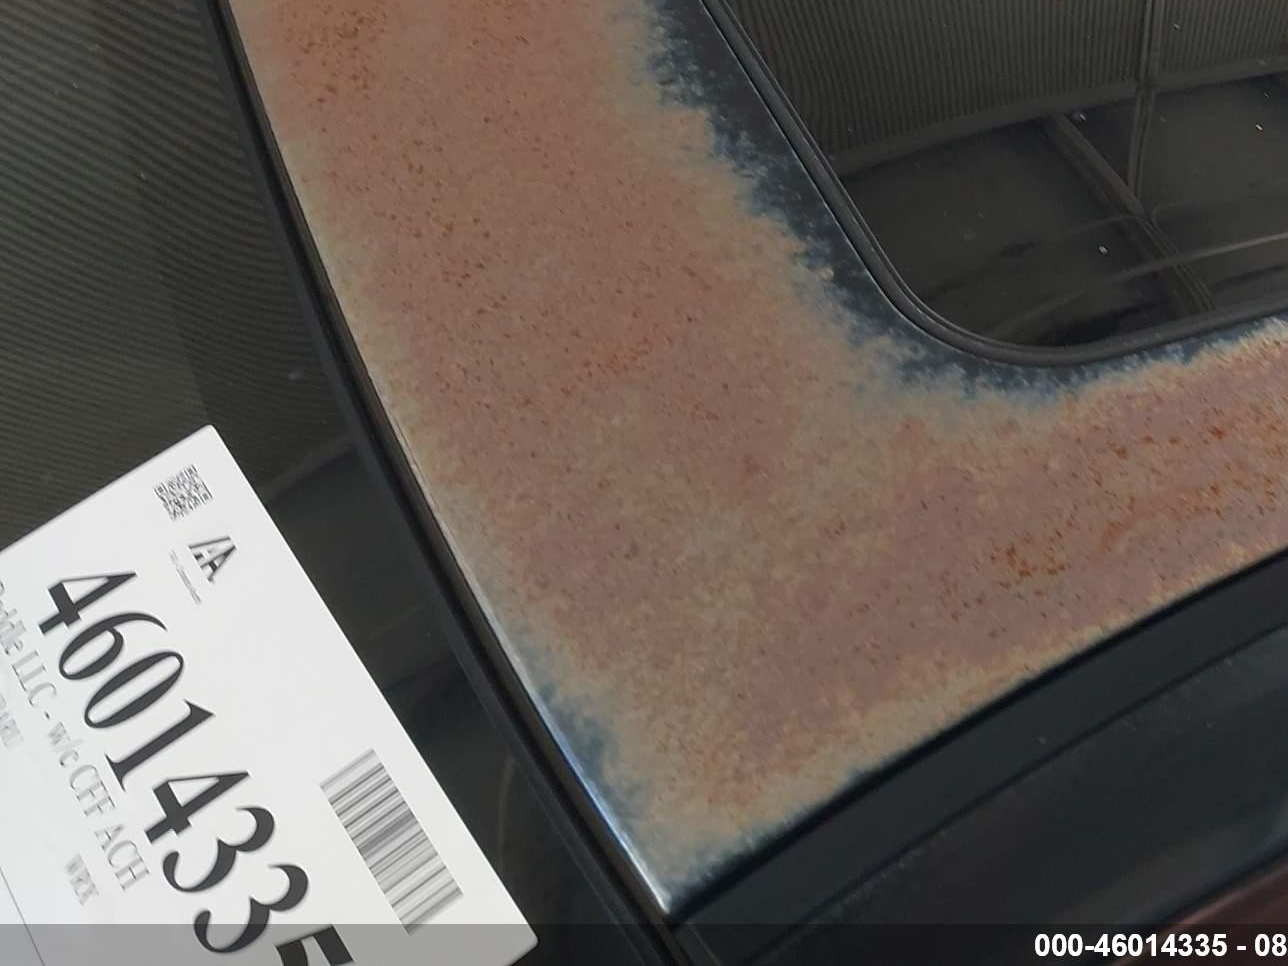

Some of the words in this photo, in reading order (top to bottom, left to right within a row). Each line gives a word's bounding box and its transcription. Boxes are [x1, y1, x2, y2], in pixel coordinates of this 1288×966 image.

[12, 649, 57, 706] LLC
[68, 764, 116, 818] CFF
[94, 823, 151, 892] ACH
